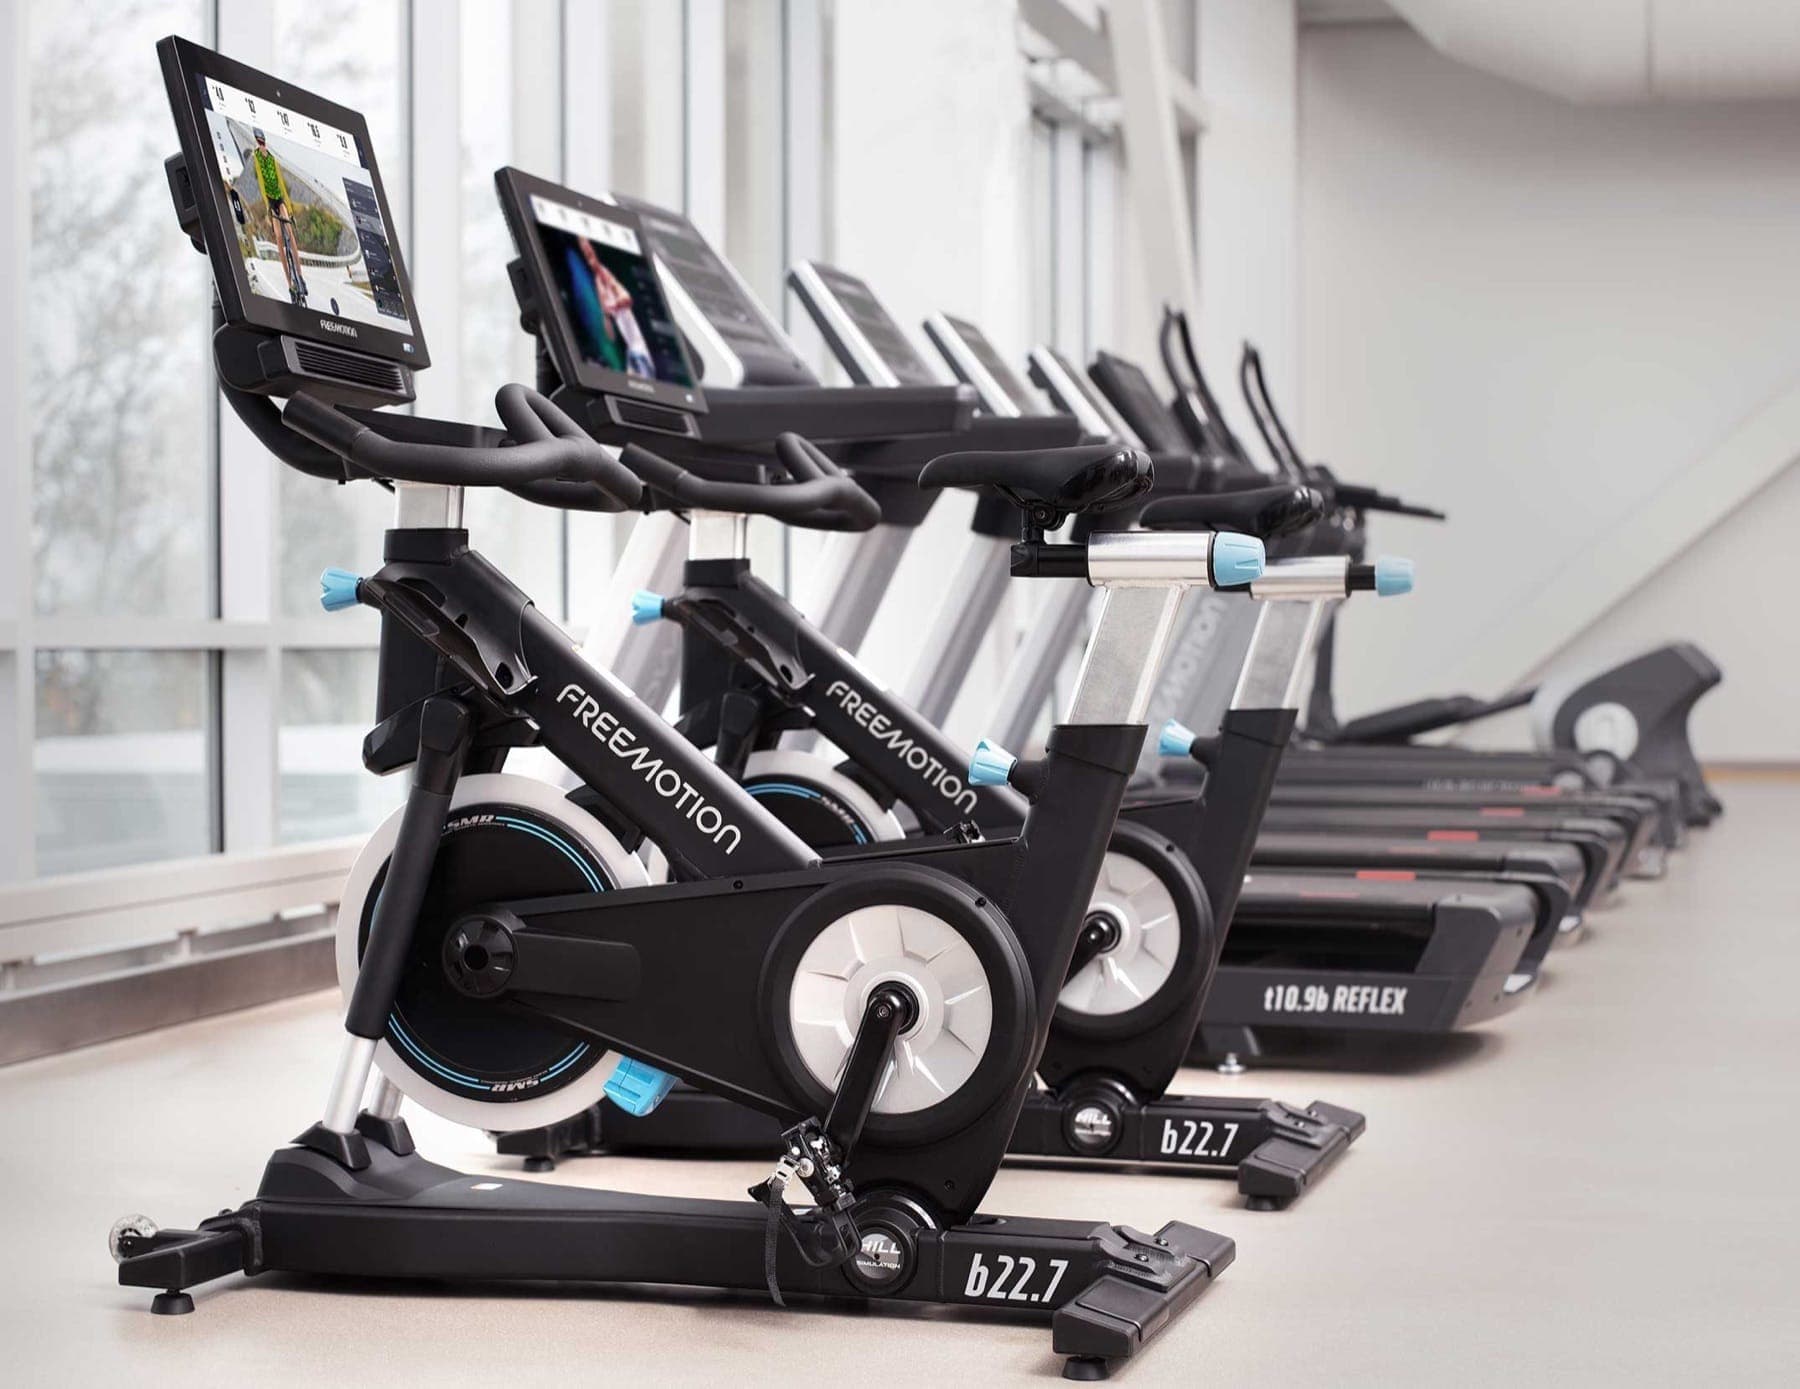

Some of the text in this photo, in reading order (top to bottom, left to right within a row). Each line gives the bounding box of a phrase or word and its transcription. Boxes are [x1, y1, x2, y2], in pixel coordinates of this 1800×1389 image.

[556, 684, 742, 855] FREEMOTION
[825, 680, 978, 814] FREEMOTION
[1264, 985, 1408, 1015] t10.9b REFLEX
[1160, 1119, 1239, 1157] b22.7
[964, 1252, 1069, 1303] b22.7
